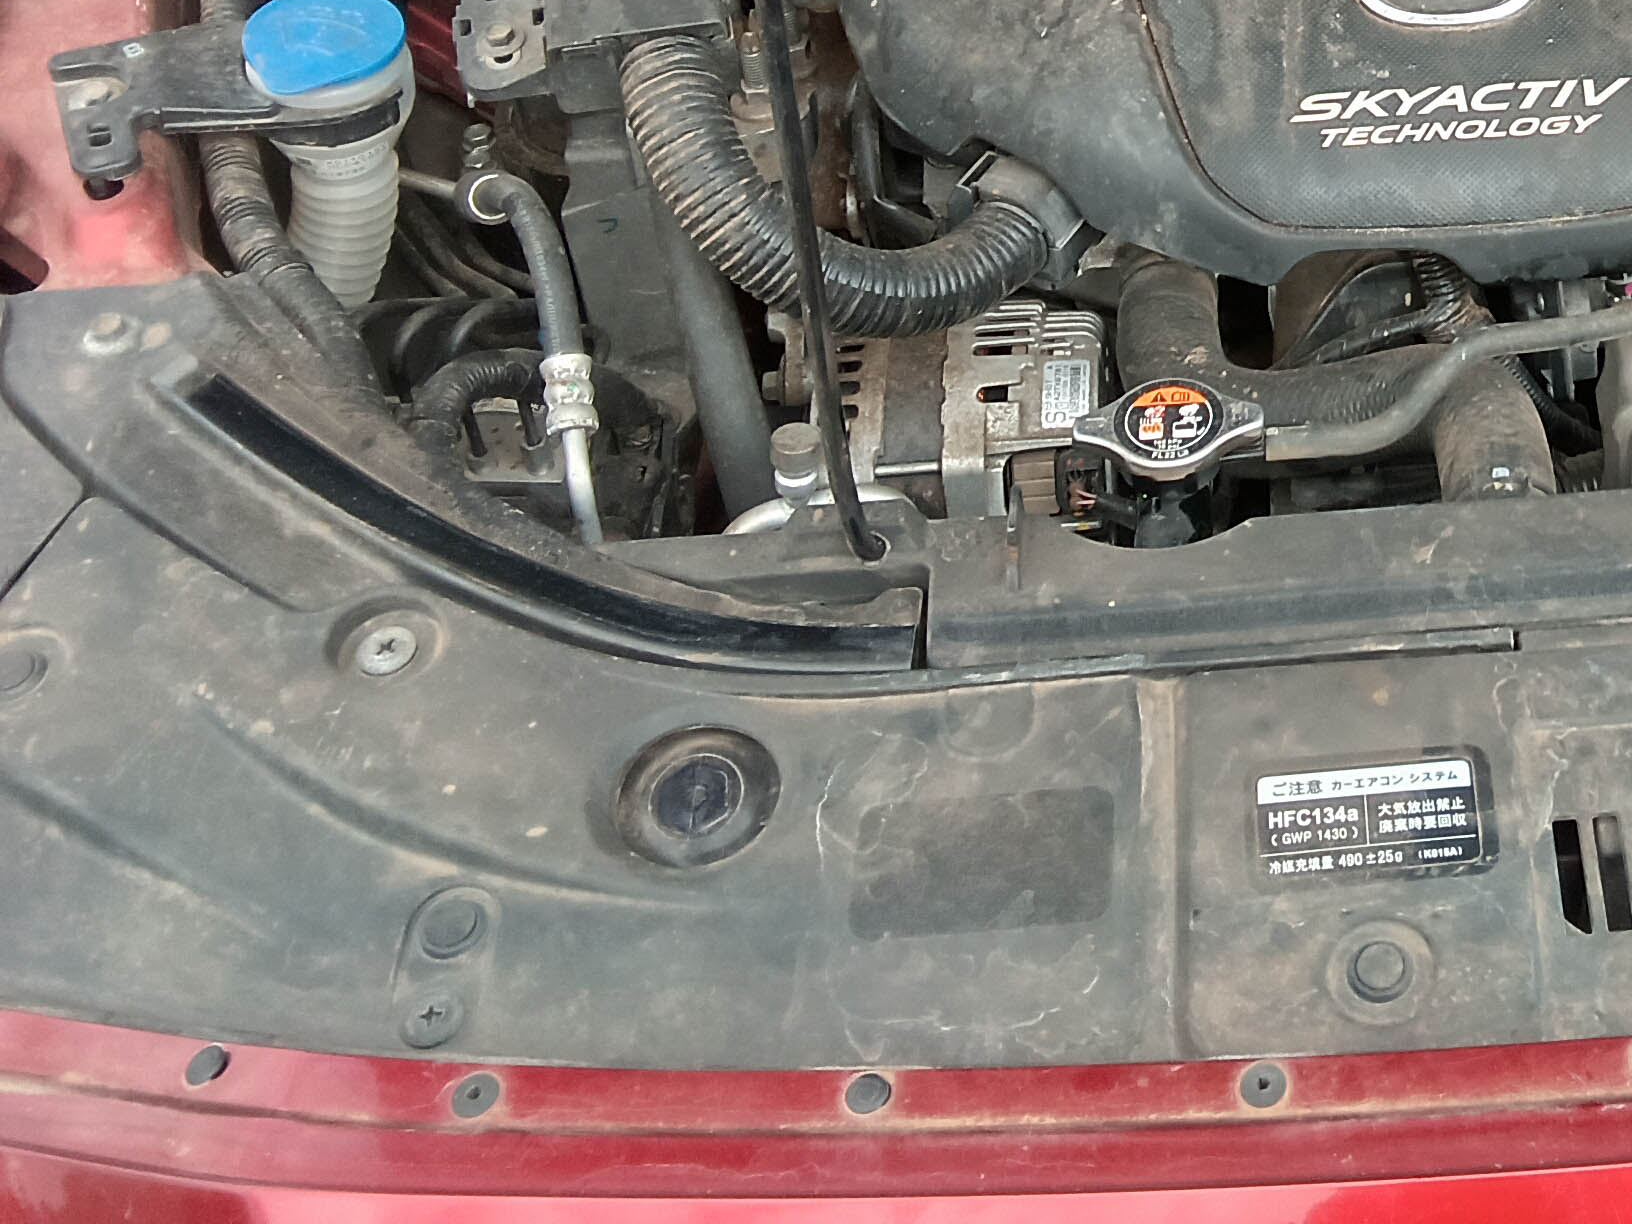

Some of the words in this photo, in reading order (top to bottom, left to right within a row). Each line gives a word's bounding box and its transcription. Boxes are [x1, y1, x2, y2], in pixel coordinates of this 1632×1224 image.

[1289, 76, 1632, 123] SKYACTIV
[1319, 113, 1603, 149] TECHNOLOGY
[1272, 779, 1323, 797] ご注意
[1331, 774, 1404, 791] カーエアコン
[1409, 770, 1459, 784] システム
[1268, 805, 1359, 829] HFC134a
